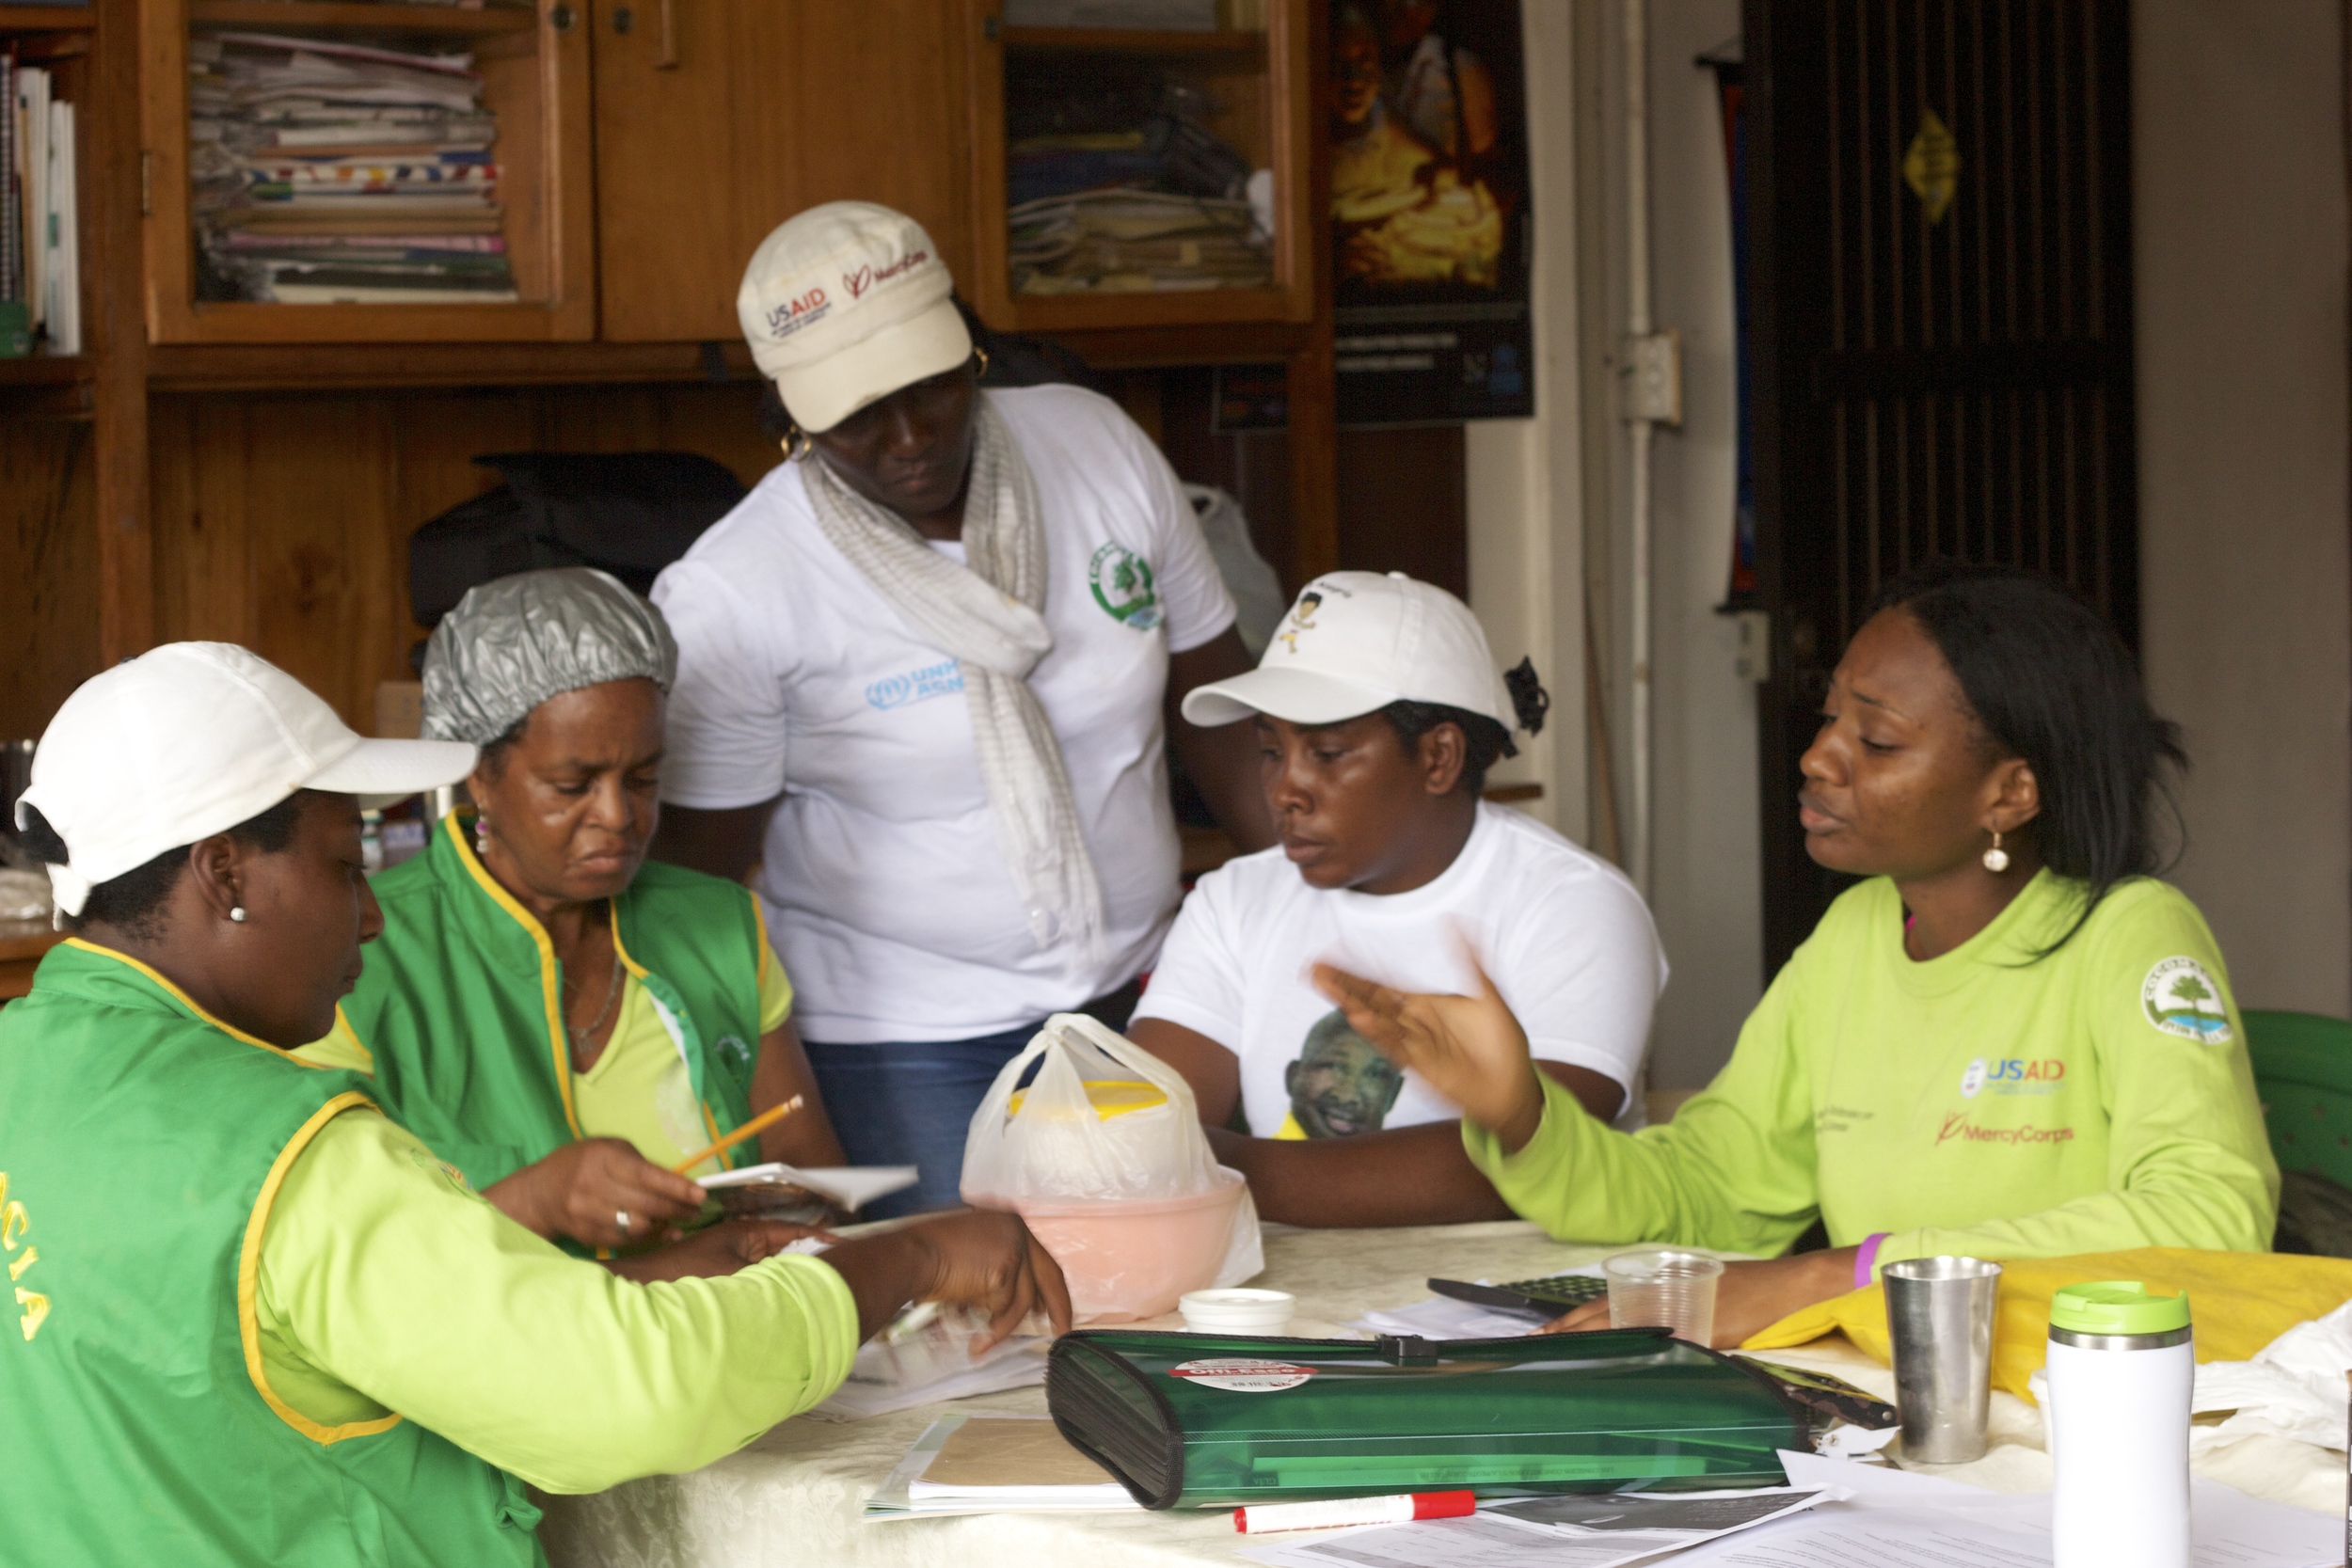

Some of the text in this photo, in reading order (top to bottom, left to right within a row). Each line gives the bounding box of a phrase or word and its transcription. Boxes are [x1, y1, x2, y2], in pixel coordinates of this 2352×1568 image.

[766, 287, 826, 327] USAID
[911, 658, 959, 681] UNH
[917, 674, 964, 696] ACN
[1986, 1058, 2066, 1082] USAID
[1963, 1124, 2074, 1146] MercyCorps
